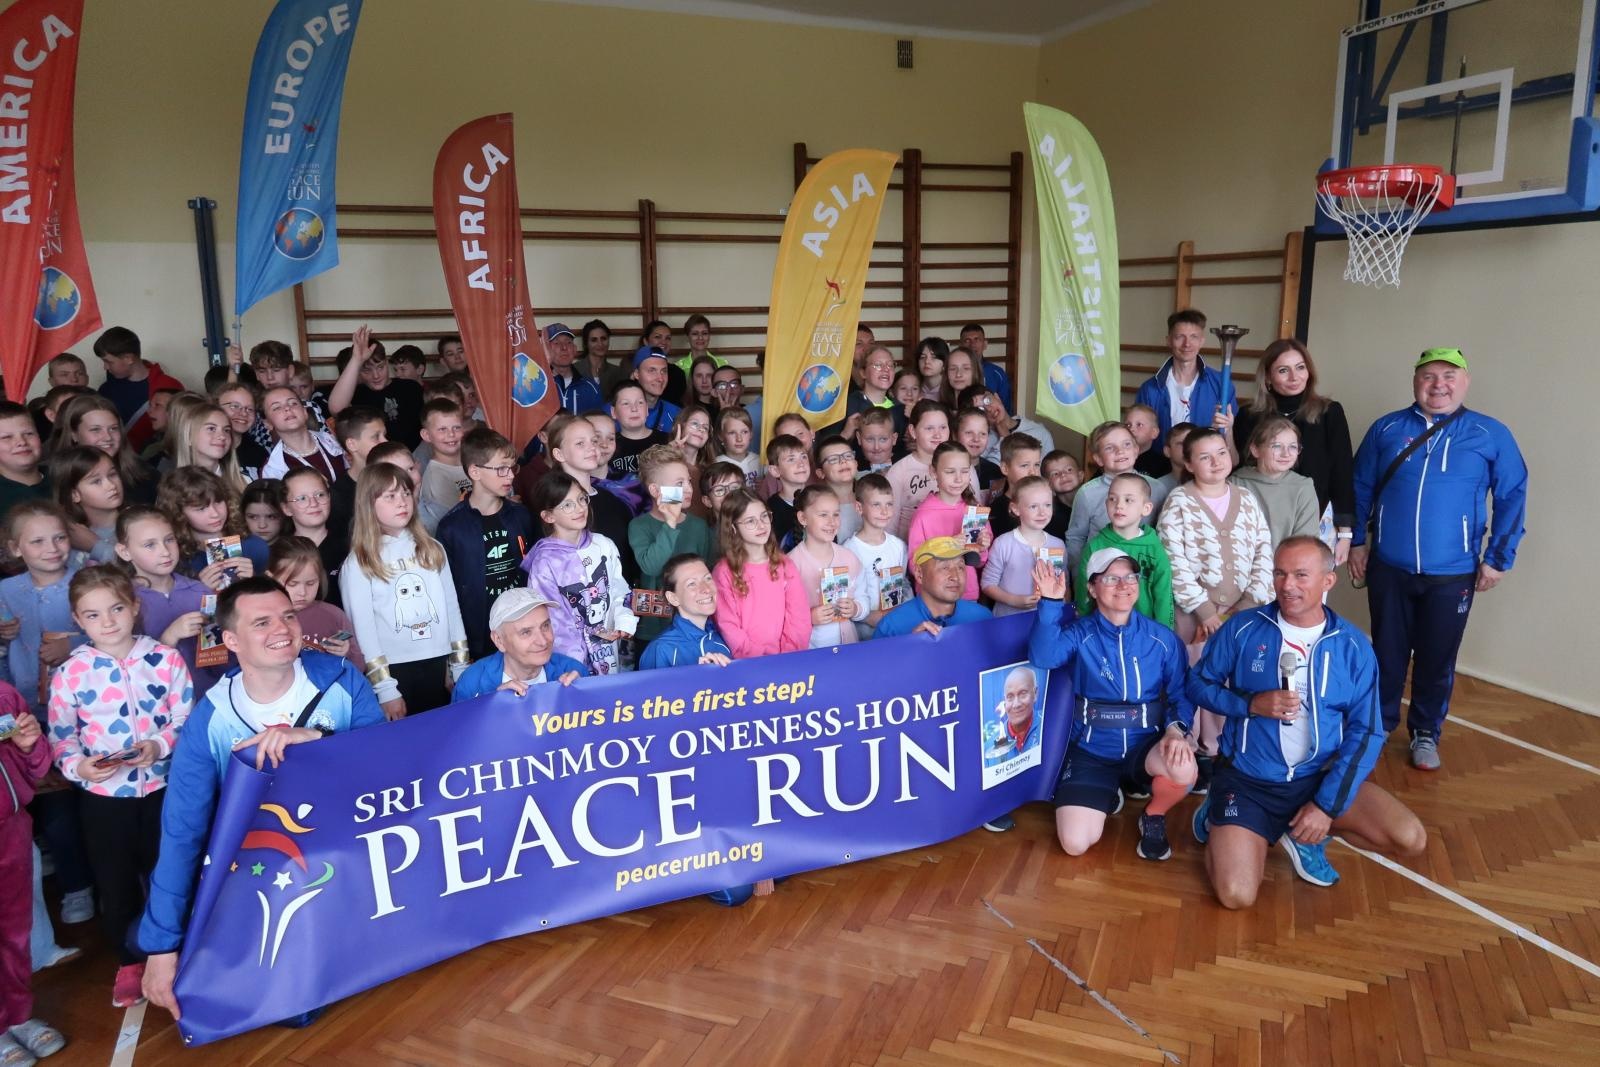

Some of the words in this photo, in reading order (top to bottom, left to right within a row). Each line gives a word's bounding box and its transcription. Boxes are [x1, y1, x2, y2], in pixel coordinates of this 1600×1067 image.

[1355, 17, 1387, 33] SPORT
[1390, 1, 1446, 22] TRANSFER
[264, 3, 351, 154] EUROPE
[0, 14, 74, 225] AMERICA
[459, 142, 510, 292] AFRICA
[801, 172, 877, 258] ASIA
[909, 475, 931, 494] Get
[486, 543, 509, 559] 4F
[532, 706, 605, 736] Yours
[613, 701, 634, 723] is
[642, 697, 686, 719] the
[692, 686, 747, 713] first
[753, 675, 816, 703] step!
[354, 778, 424, 823] SRI
[438, 734, 656, 800] CHINMOY
[669, 686, 960, 759] ONENESS-HOME
[995, 766, 1005, 777] Sri
[1005, 754, 1031, 772] Chinmoy
[355, 766, 702, 920] PEACE
[747, 721, 960, 827] RUN
[615, 841, 763, 891] peacerun.org
